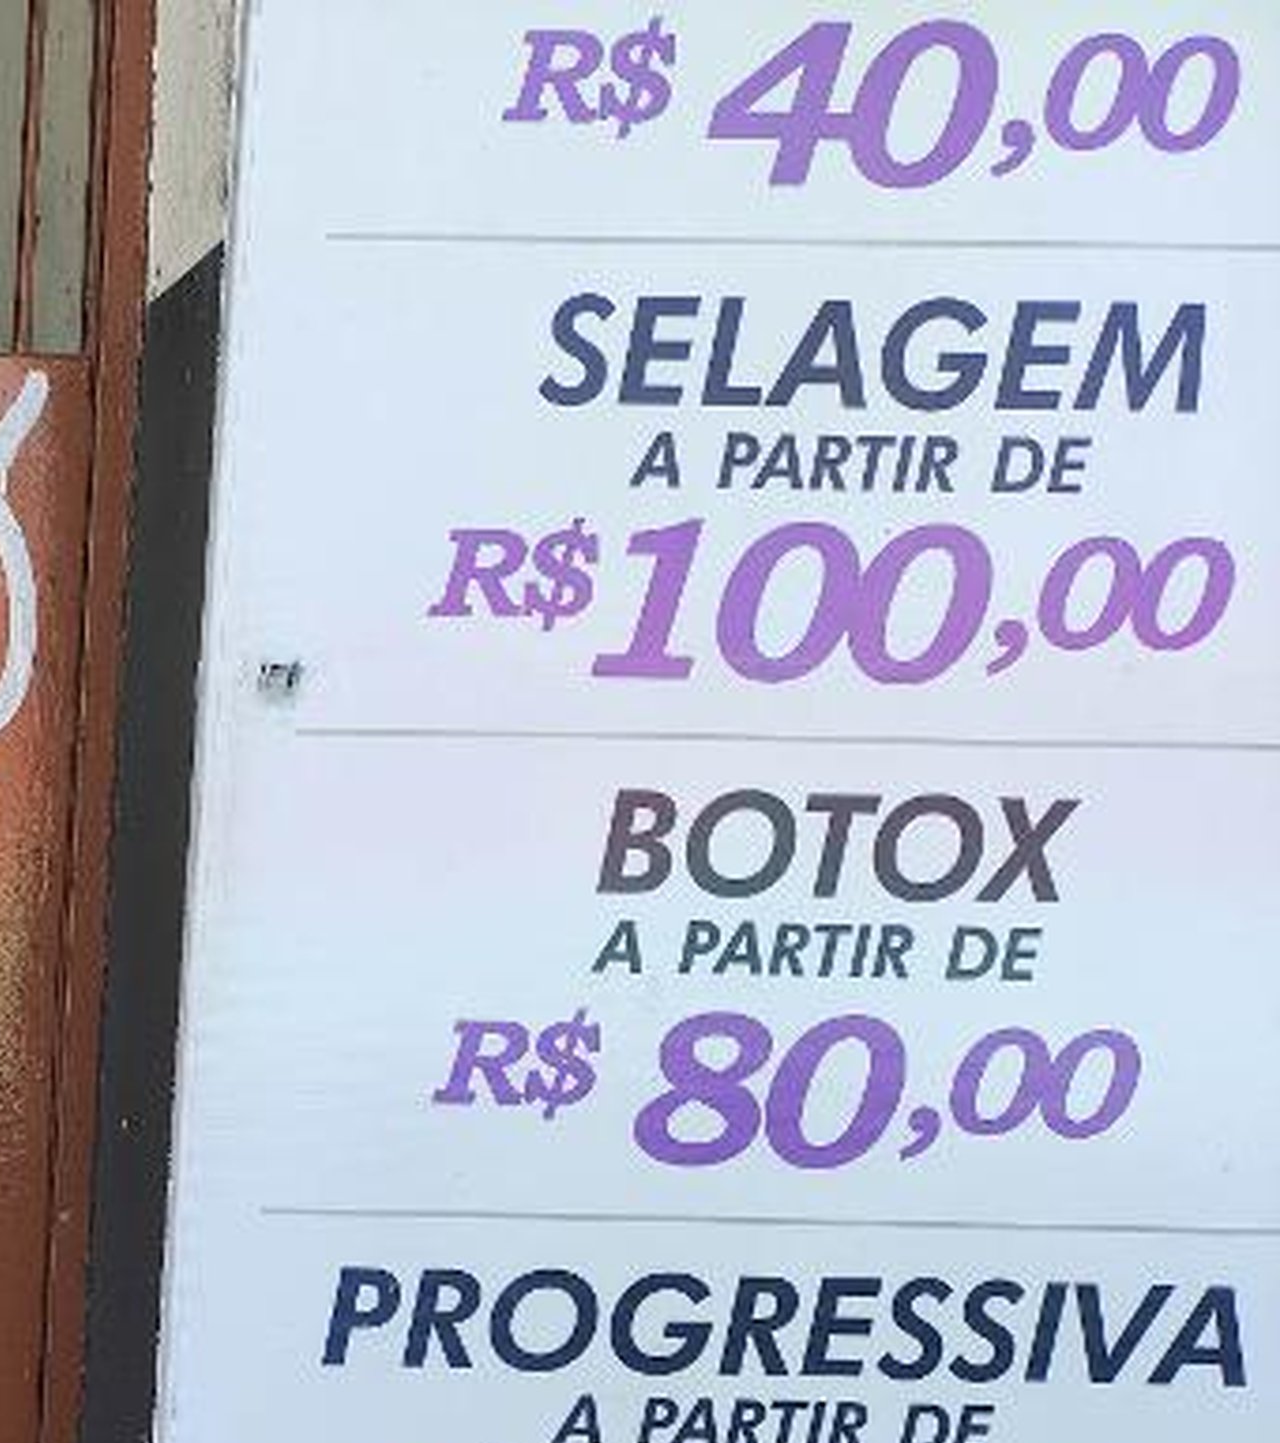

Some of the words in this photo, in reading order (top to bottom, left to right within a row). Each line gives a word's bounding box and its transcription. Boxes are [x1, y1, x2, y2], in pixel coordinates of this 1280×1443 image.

[538, 292, 1207, 415] SELAGEM
[629, 430, 682, 489] A
[717, 431, 958, 494] PARTIR
[991, 436, 1092, 495] DE
[596, 788, 1084, 904] BOTOX
[592, 919, 643, 976] A
[678, 920, 914, 979] PARTIR
[945, 924, 1043, 983] DE
[321, 1265, 1248, 1388] PROGRESSIVA
